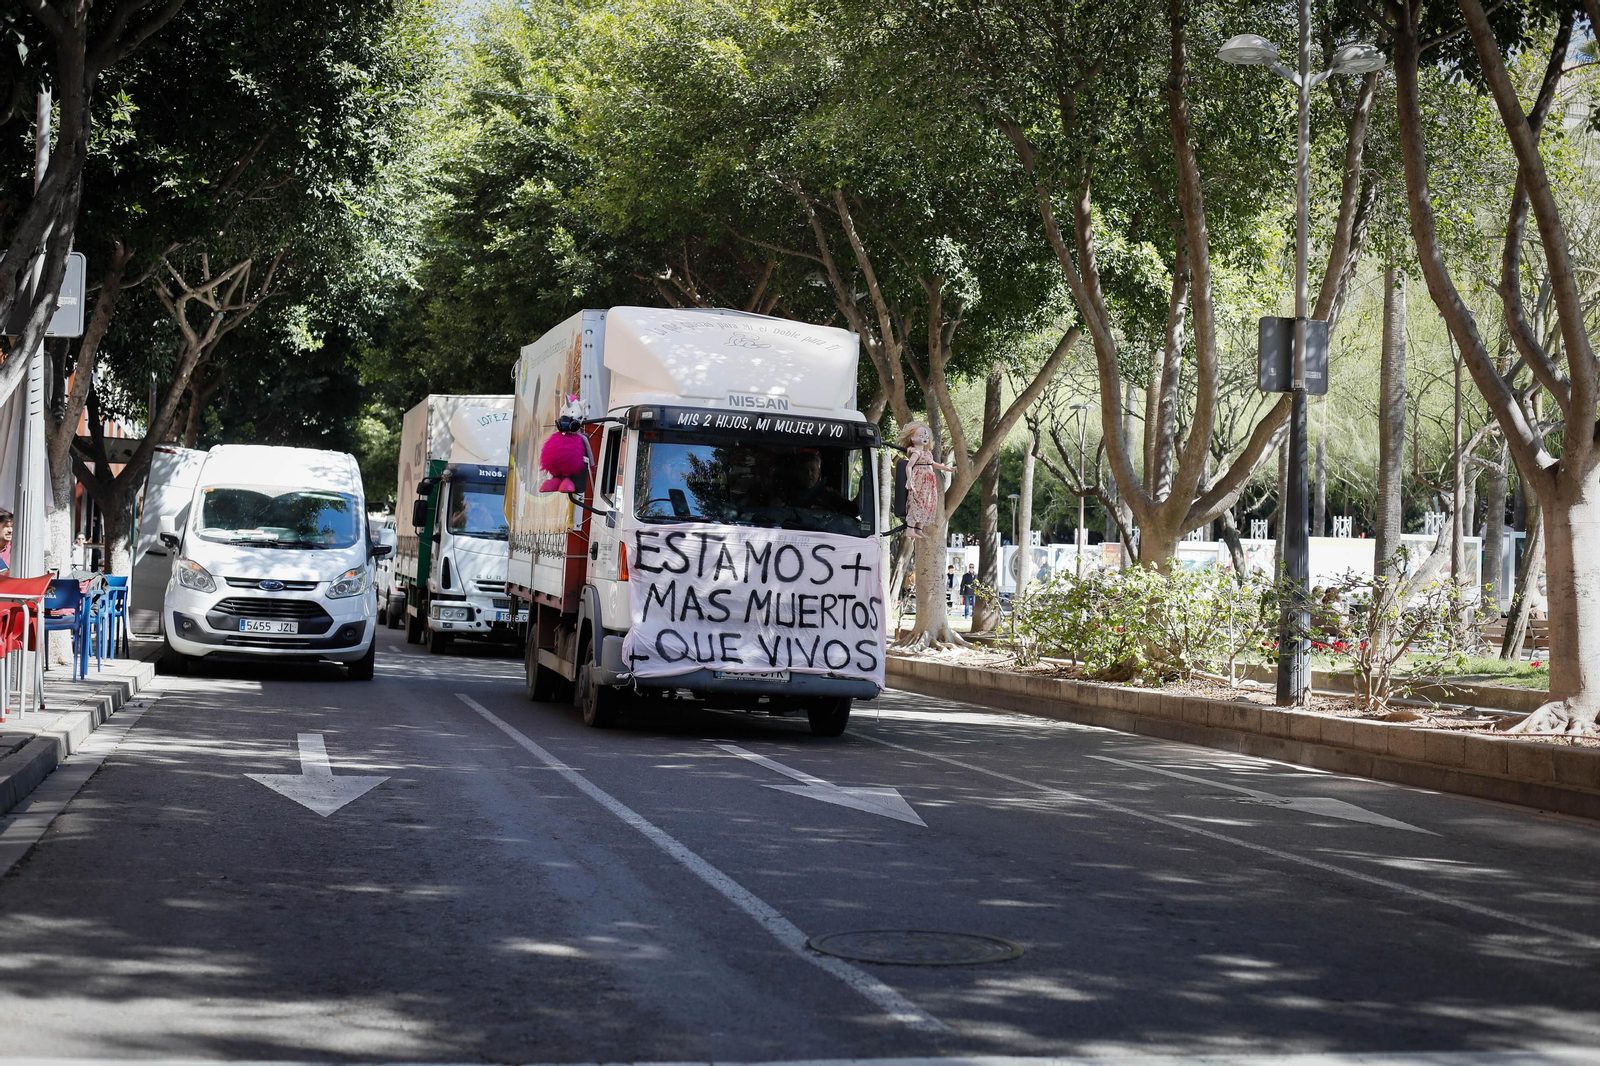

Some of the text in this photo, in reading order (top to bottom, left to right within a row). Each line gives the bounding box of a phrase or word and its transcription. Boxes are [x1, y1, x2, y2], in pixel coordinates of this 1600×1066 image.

[773, 327, 800, 339] Doble
[728, 394, 789, 411] NISSAN
[477, 412, 509, 427] LOPEZ
[677, 412, 844, 438] MIS 2 HIJOS, MI MUJER Y YO
[633, 529, 836, 586] ESTAMOS
[642, 580, 882, 632] MAS MUERTOS
[246, 620, 295, 632] 5455 JZL
[655, 628, 744, 665] QUE
[757, 634, 878, 672] VIVOS
